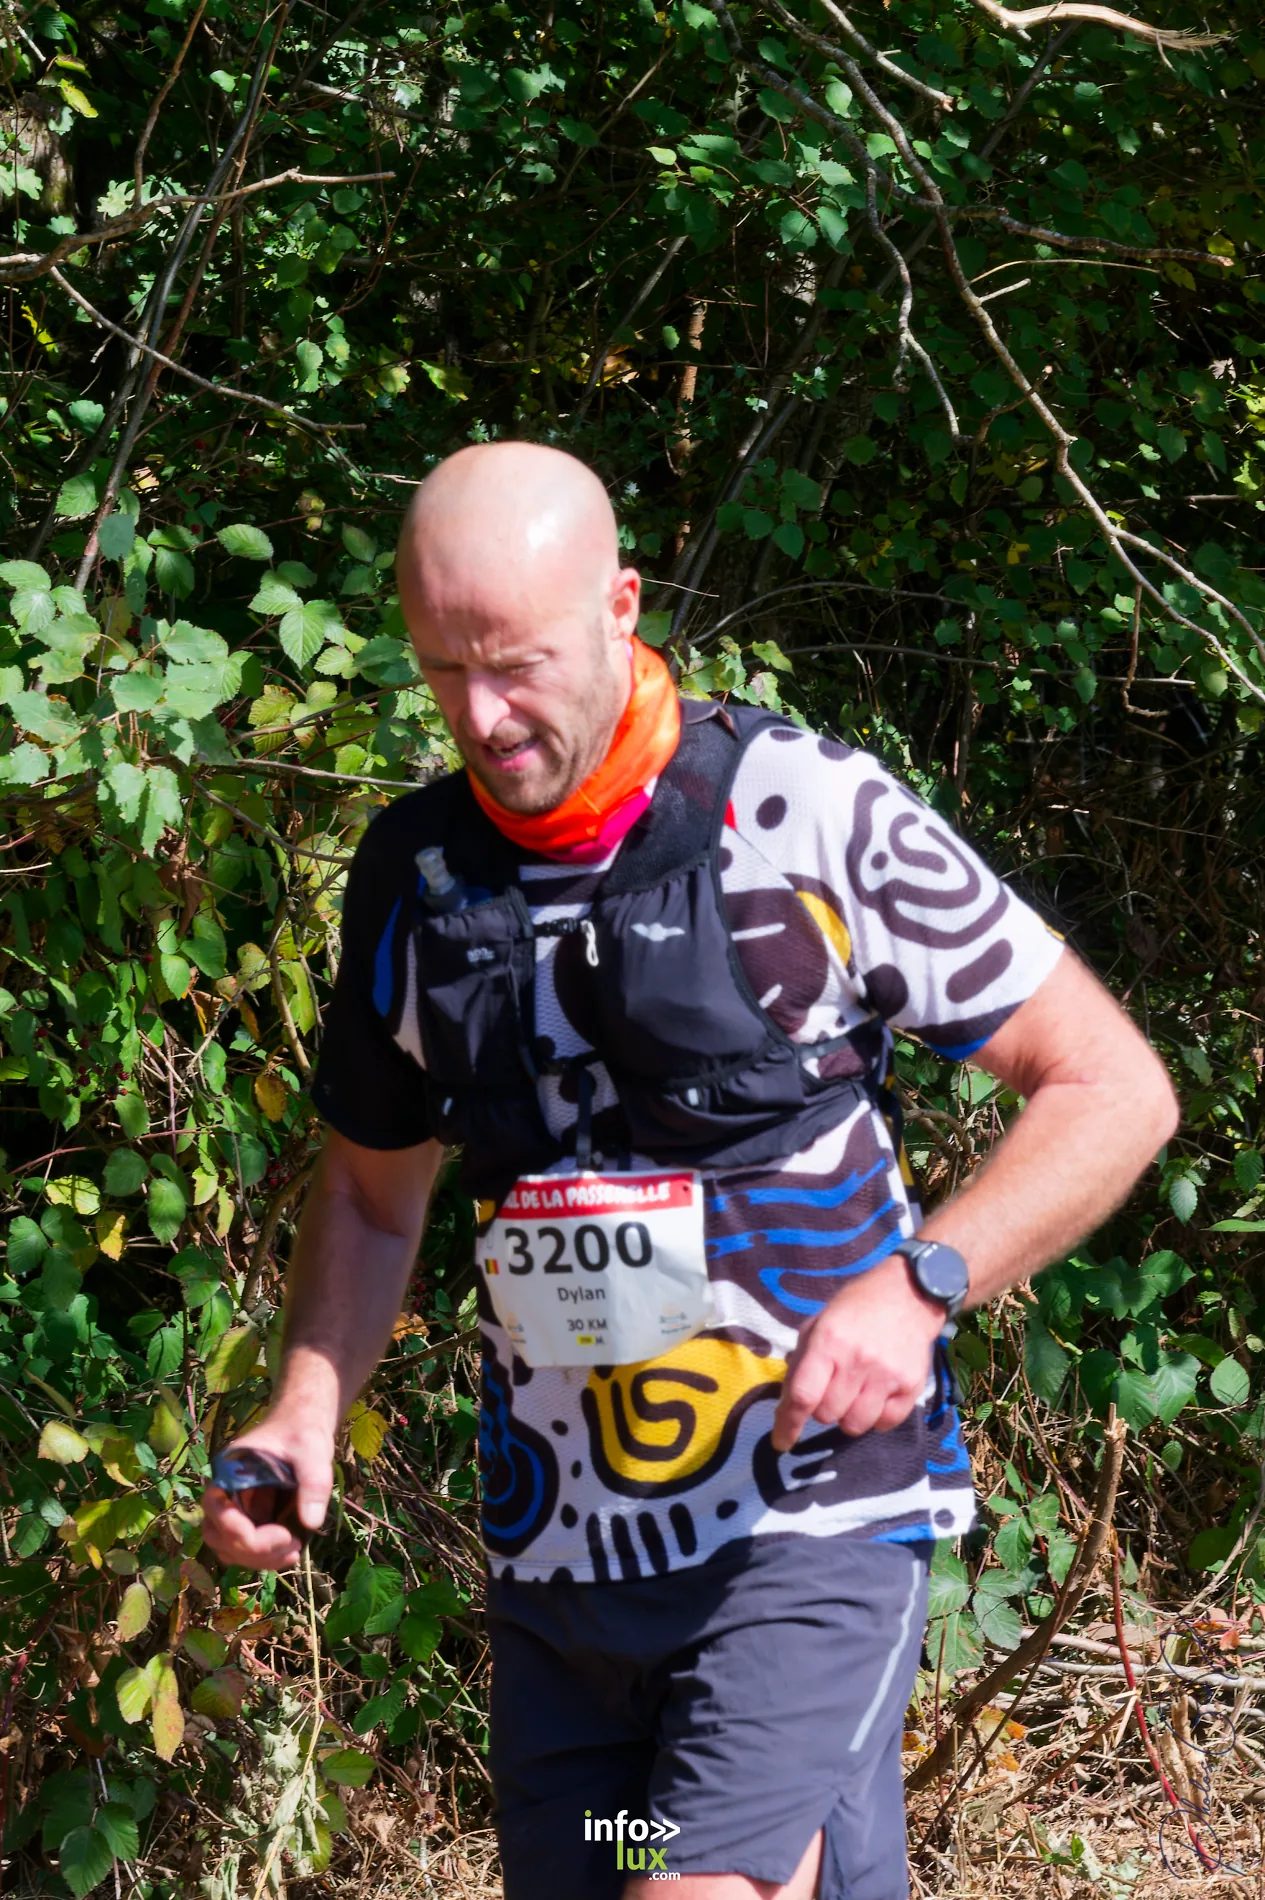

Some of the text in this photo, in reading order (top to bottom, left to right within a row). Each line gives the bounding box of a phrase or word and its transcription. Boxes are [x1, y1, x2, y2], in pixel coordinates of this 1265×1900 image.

[520, 1189, 541, 1209] DE
[541, 1188, 564, 1209] LA
[504, 1221, 653, 1276] 3200
[557, 1285, 606, 1304] Dylan
[566, 1317, 609, 1332] 30 KM
